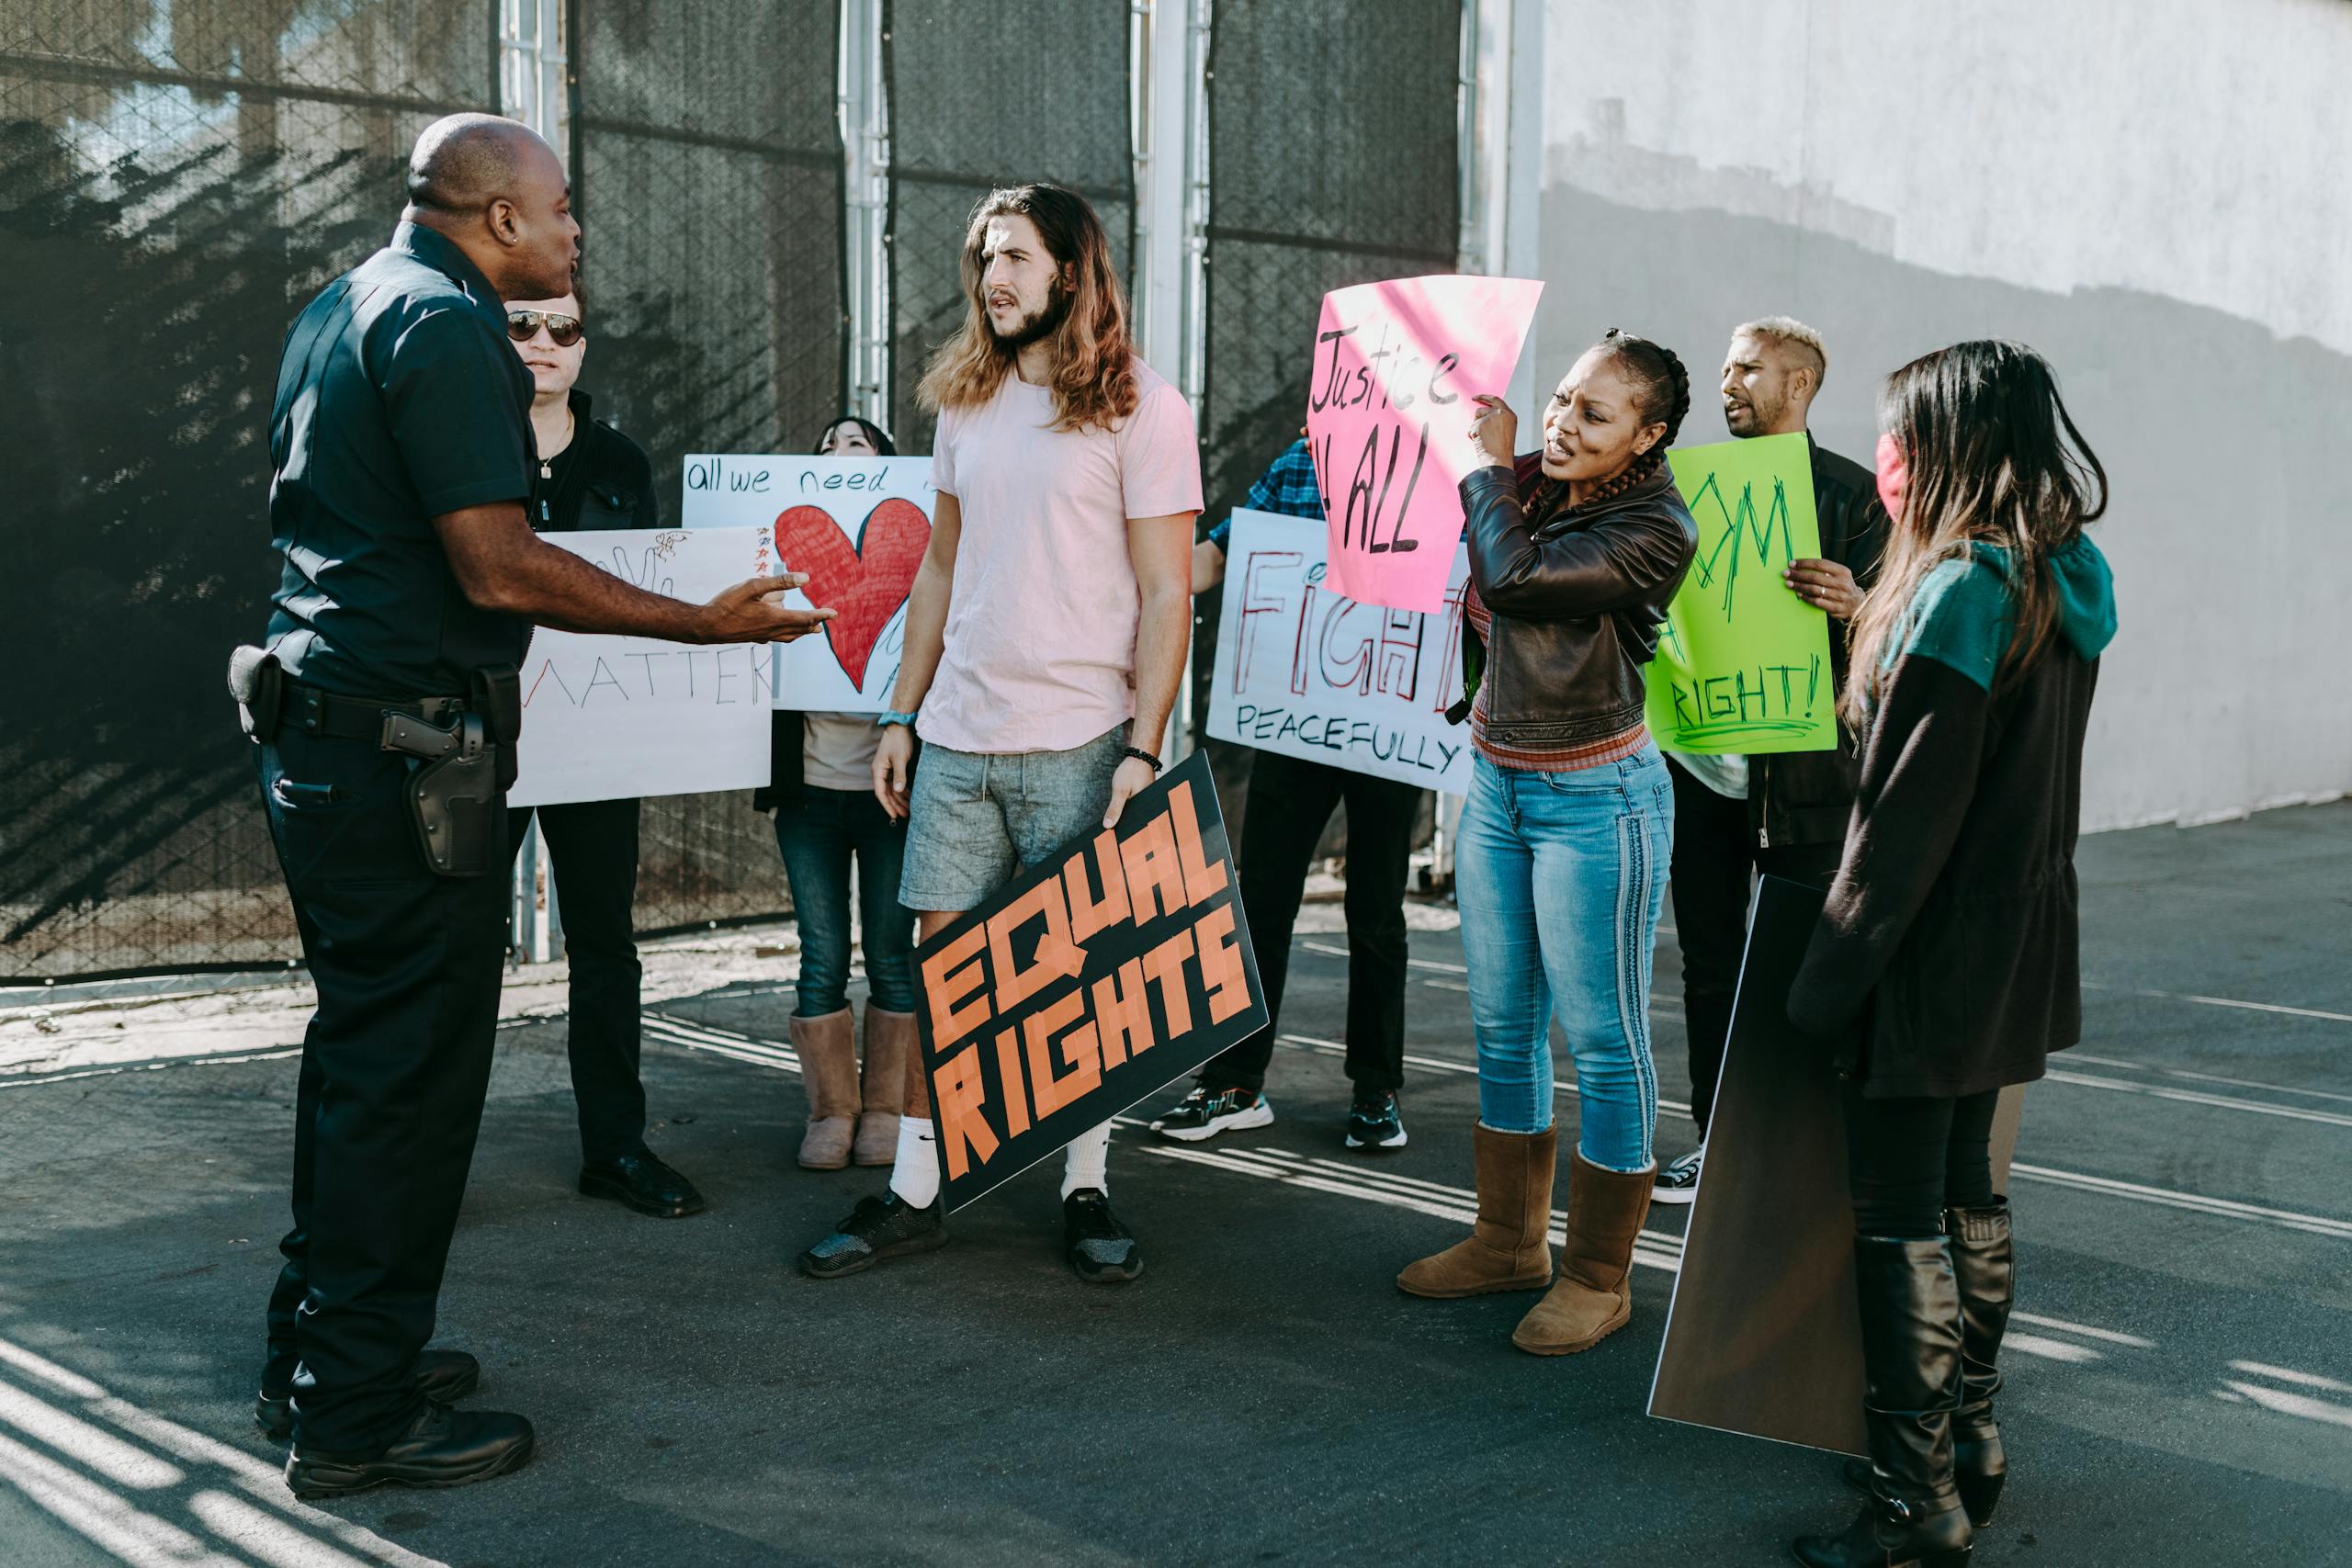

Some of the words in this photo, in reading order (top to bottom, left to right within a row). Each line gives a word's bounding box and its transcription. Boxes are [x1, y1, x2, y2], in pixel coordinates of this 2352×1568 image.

[1312, 323, 1460, 413] Justice
[731, 470, 771, 493] we
[799, 466, 888, 494] need
[1344, 422, 1430, 554] ALL
[1670, 653, 1820, 733] RIGHT!
[1237, 705, 1463, 774] PEACEFULLY
[922, 780, 1228, 1055] EQUAL
[933, 903, 1252, 1182] RIGHTS
